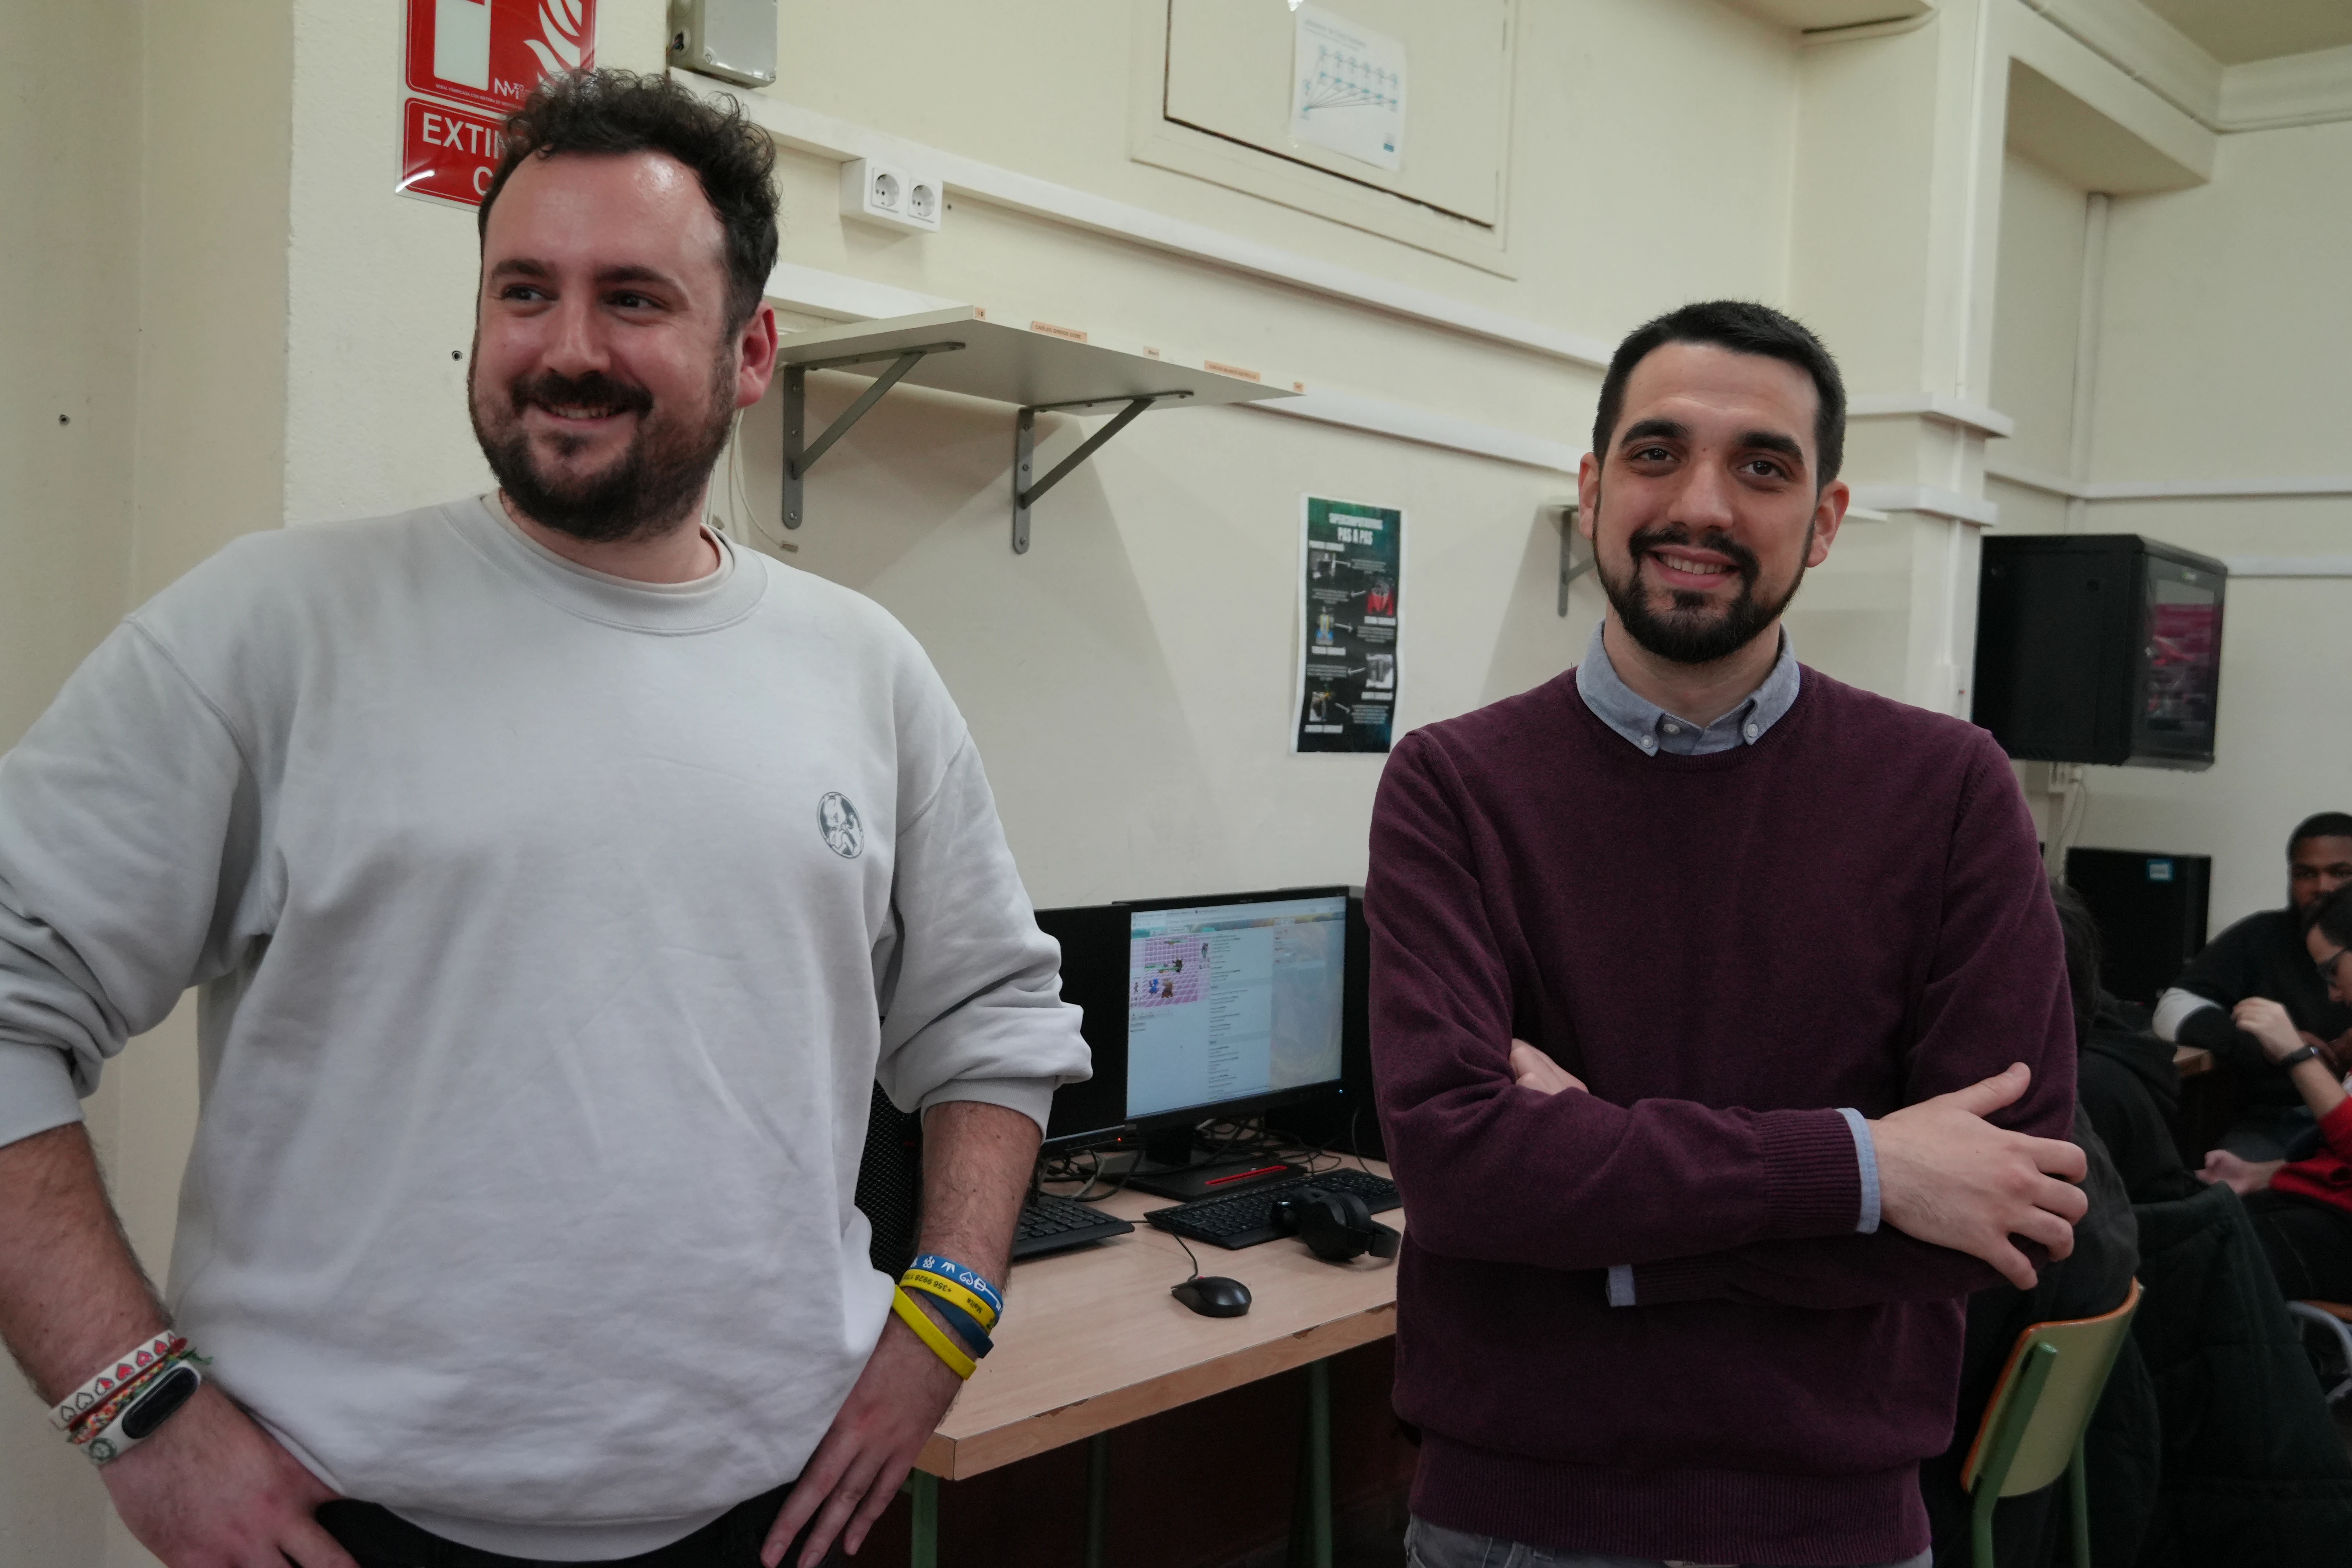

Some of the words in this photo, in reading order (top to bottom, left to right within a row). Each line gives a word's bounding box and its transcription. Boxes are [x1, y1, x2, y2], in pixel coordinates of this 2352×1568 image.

[915, 1274, 932, 1285] 9928
[934, 1281, 952, 1292] +356
[967, 1298, 983, 1314] Malta
